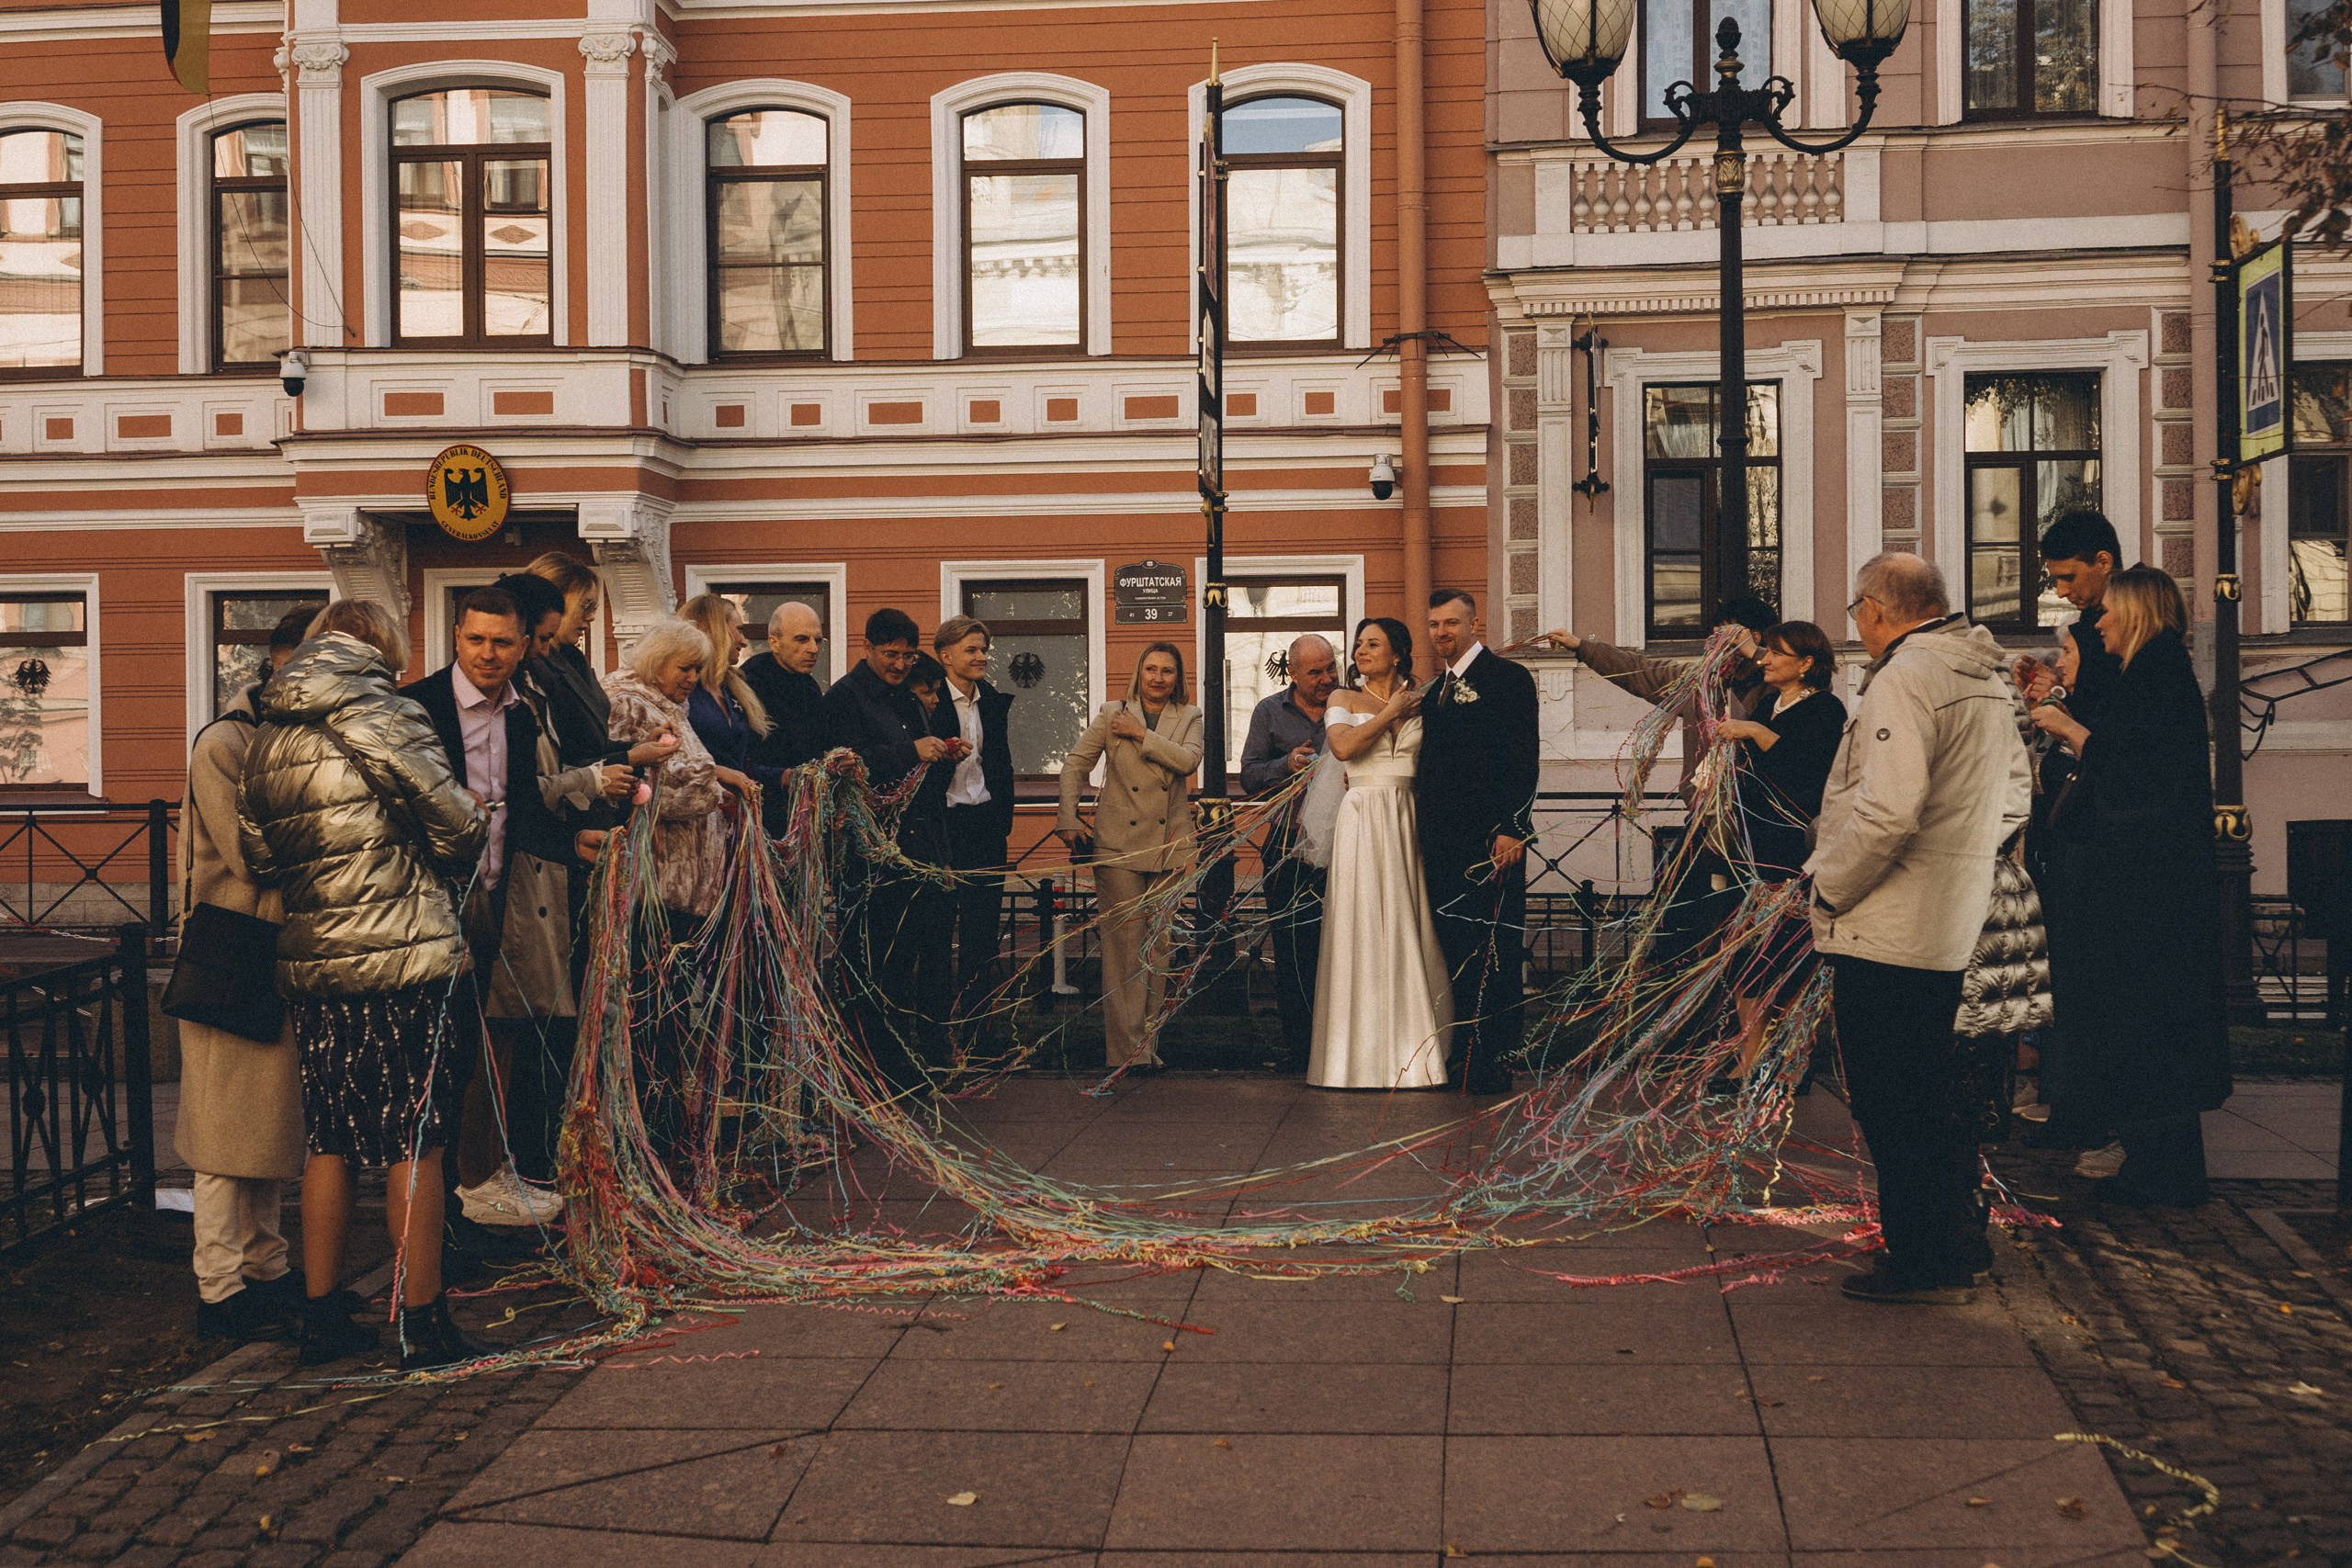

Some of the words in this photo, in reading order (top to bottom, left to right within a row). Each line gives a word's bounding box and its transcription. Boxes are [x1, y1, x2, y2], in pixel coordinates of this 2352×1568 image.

[429, 447, 469, 500] BUNDESREPUBLIK
[470, 449, 507, 499] DEUTSCHLAND
[441, 520, 499, 539] GENERALKONSULAT
[1119, 577, 1182, 587] ФУРШТАТСКАЯ
[1145, 608, 1158, 620] 39
